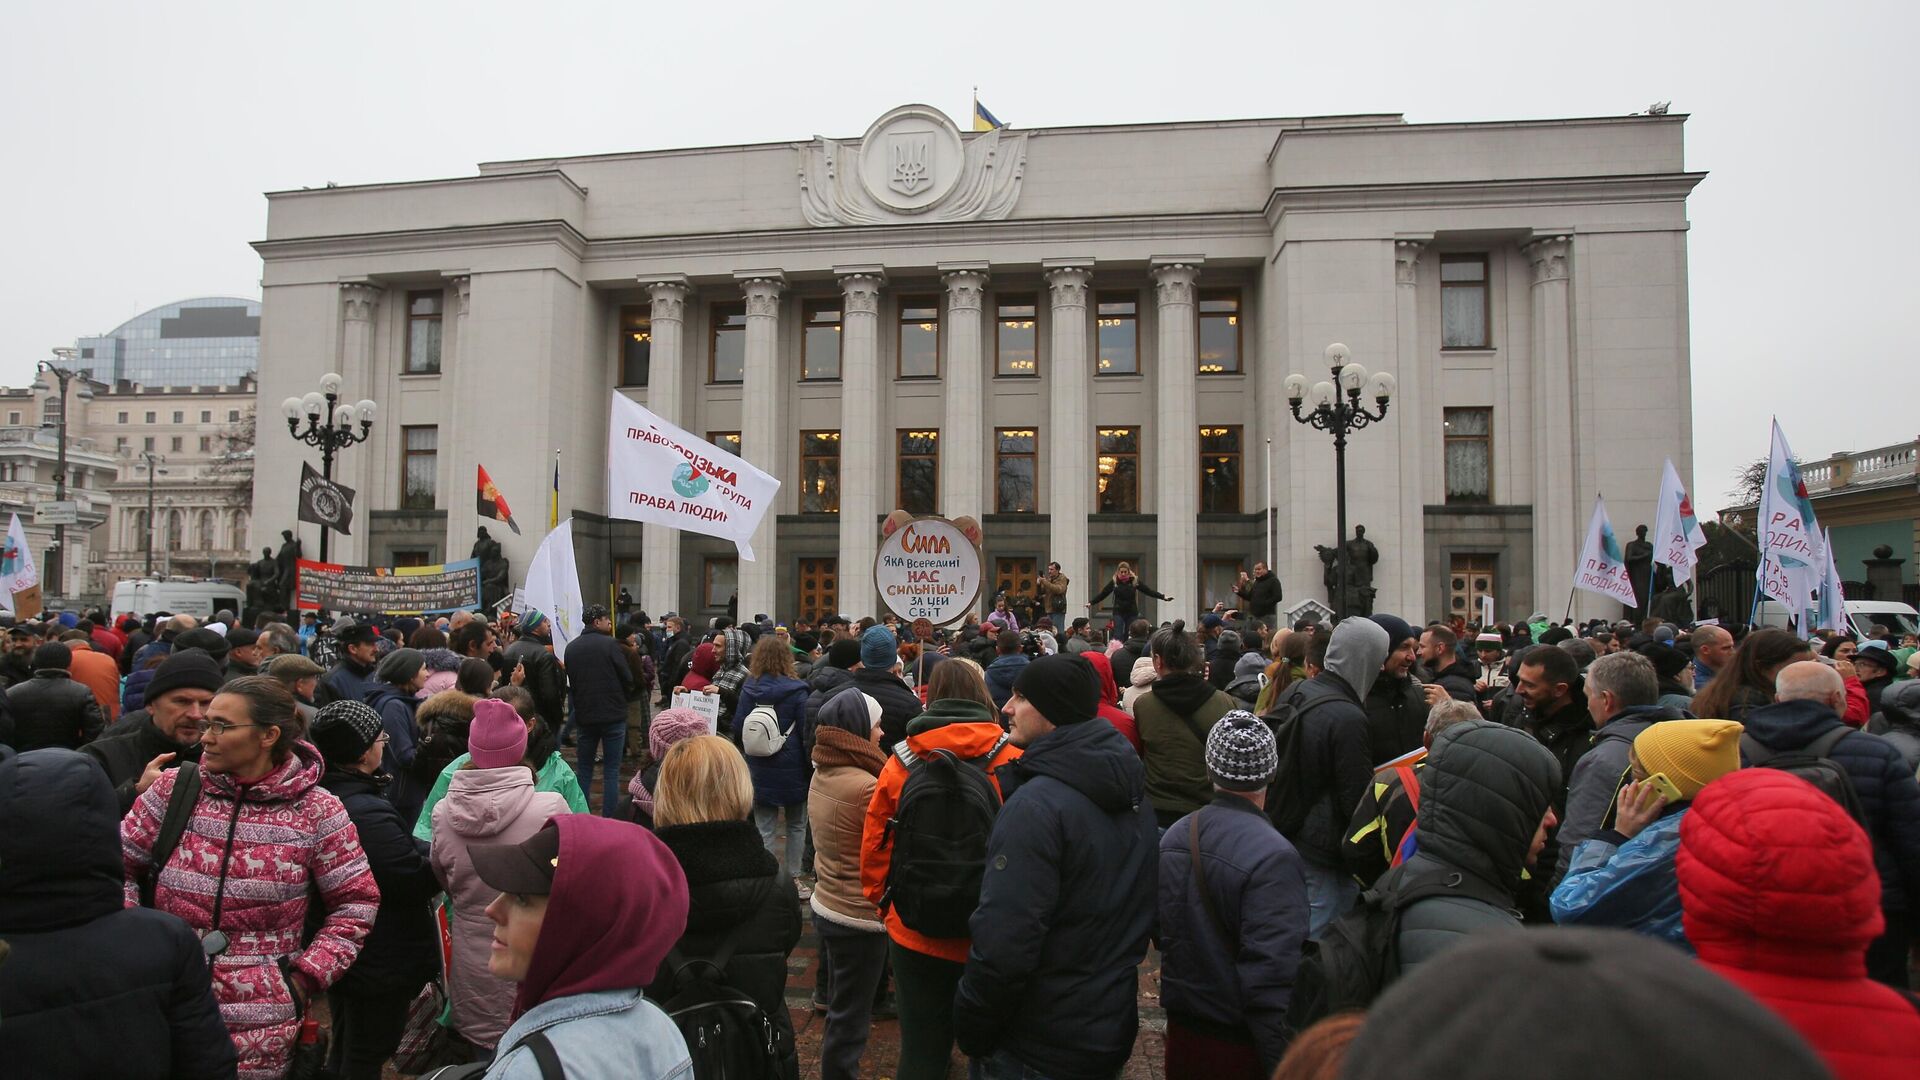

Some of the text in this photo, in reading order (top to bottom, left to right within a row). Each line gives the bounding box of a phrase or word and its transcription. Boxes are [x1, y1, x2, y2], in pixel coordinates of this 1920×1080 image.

[629, 491, 675, 512] ПРАВА
[884, 556, 904, 567] ЯКА
[1586, 558, 1629, 581] ПРАВ
[908, 570, 940, 583] НАС
[910, 596, 950, 608] ЗА ЦЕЙ
